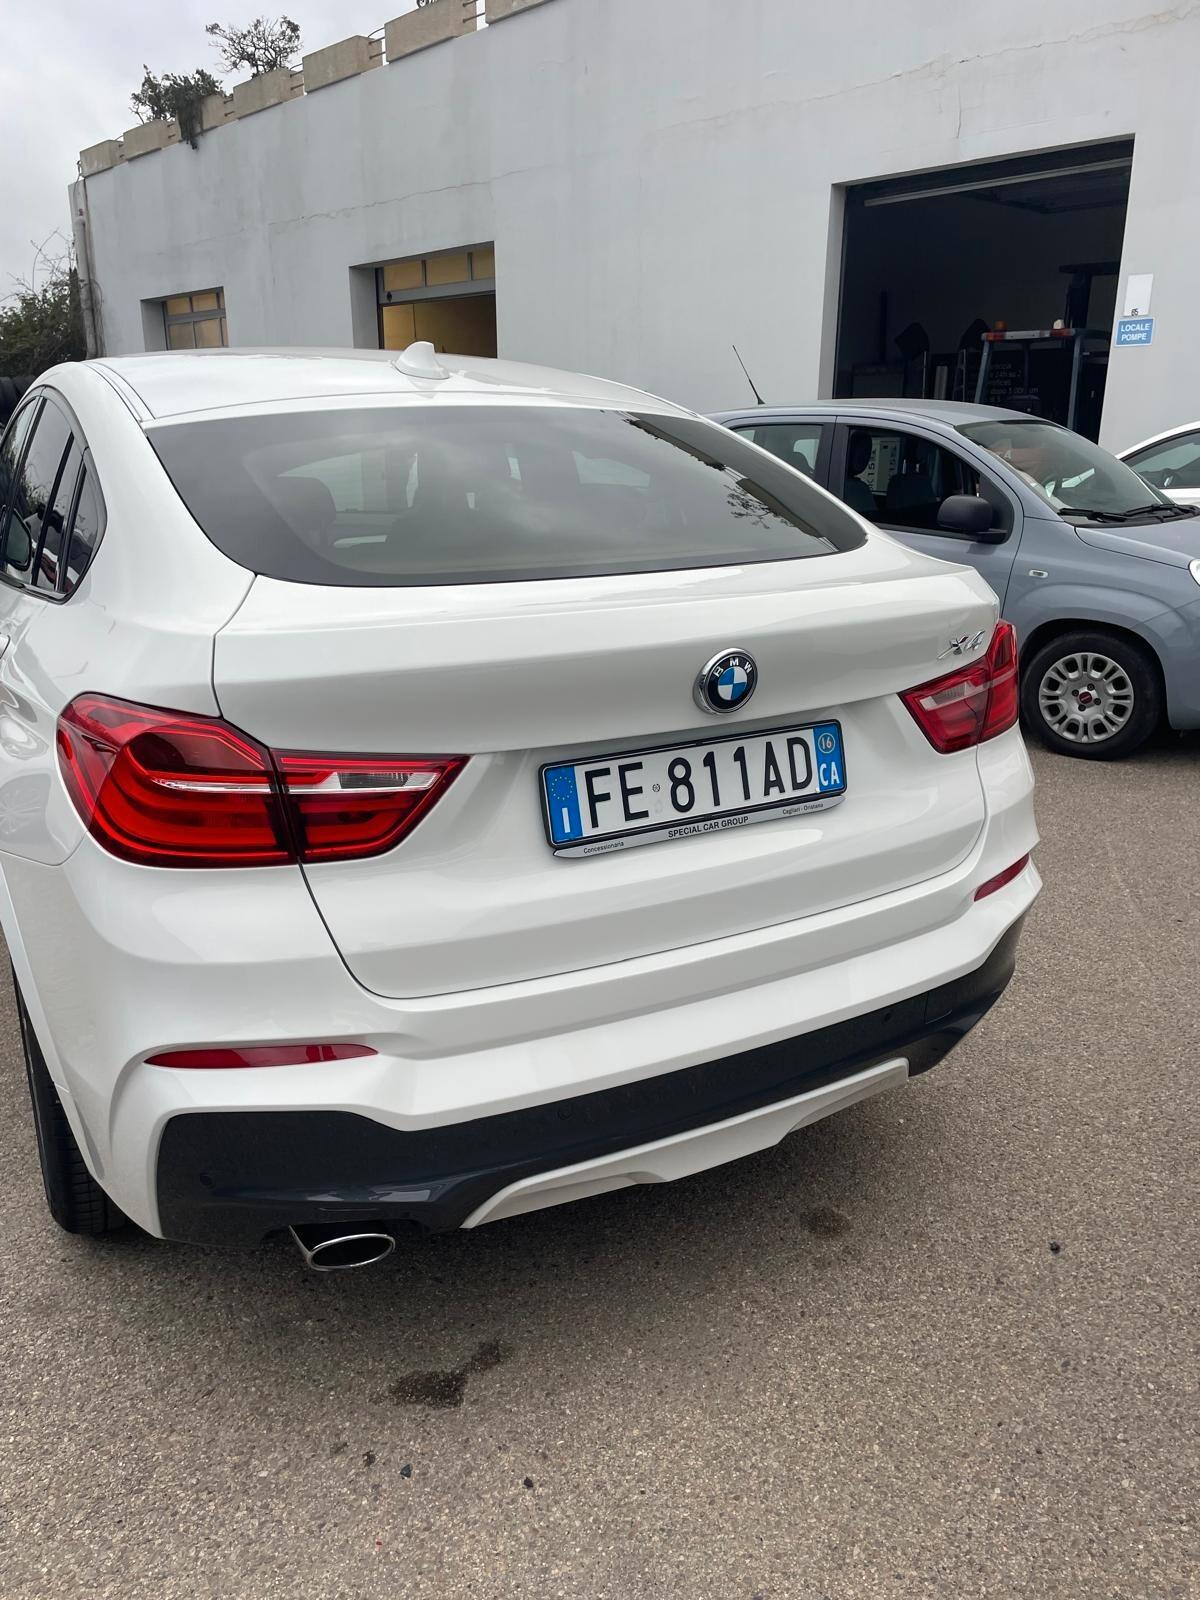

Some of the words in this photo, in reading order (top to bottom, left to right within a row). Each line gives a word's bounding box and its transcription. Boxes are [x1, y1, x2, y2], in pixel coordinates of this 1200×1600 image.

[1121, 323, 1151, 332] LOCALE
[1121, 333, 1147, 342] POMPE
[937, 630, 985, 660] X4
[713, 657, 753, 678] BMW
[820, 736, 832, 750] 16
[584, 761, 649, 829] FE
[667, 736, 813, 814] 811AD
[819, 761, 840, 786] CA
[561, 807, 571, 833] I
[668, 825, 702, 838] SPECIAL
[703, 821, 719, 831] CAR
[721, 815, 749, 828] GROUP
[583, 840, 625, 854] Concessionaria
